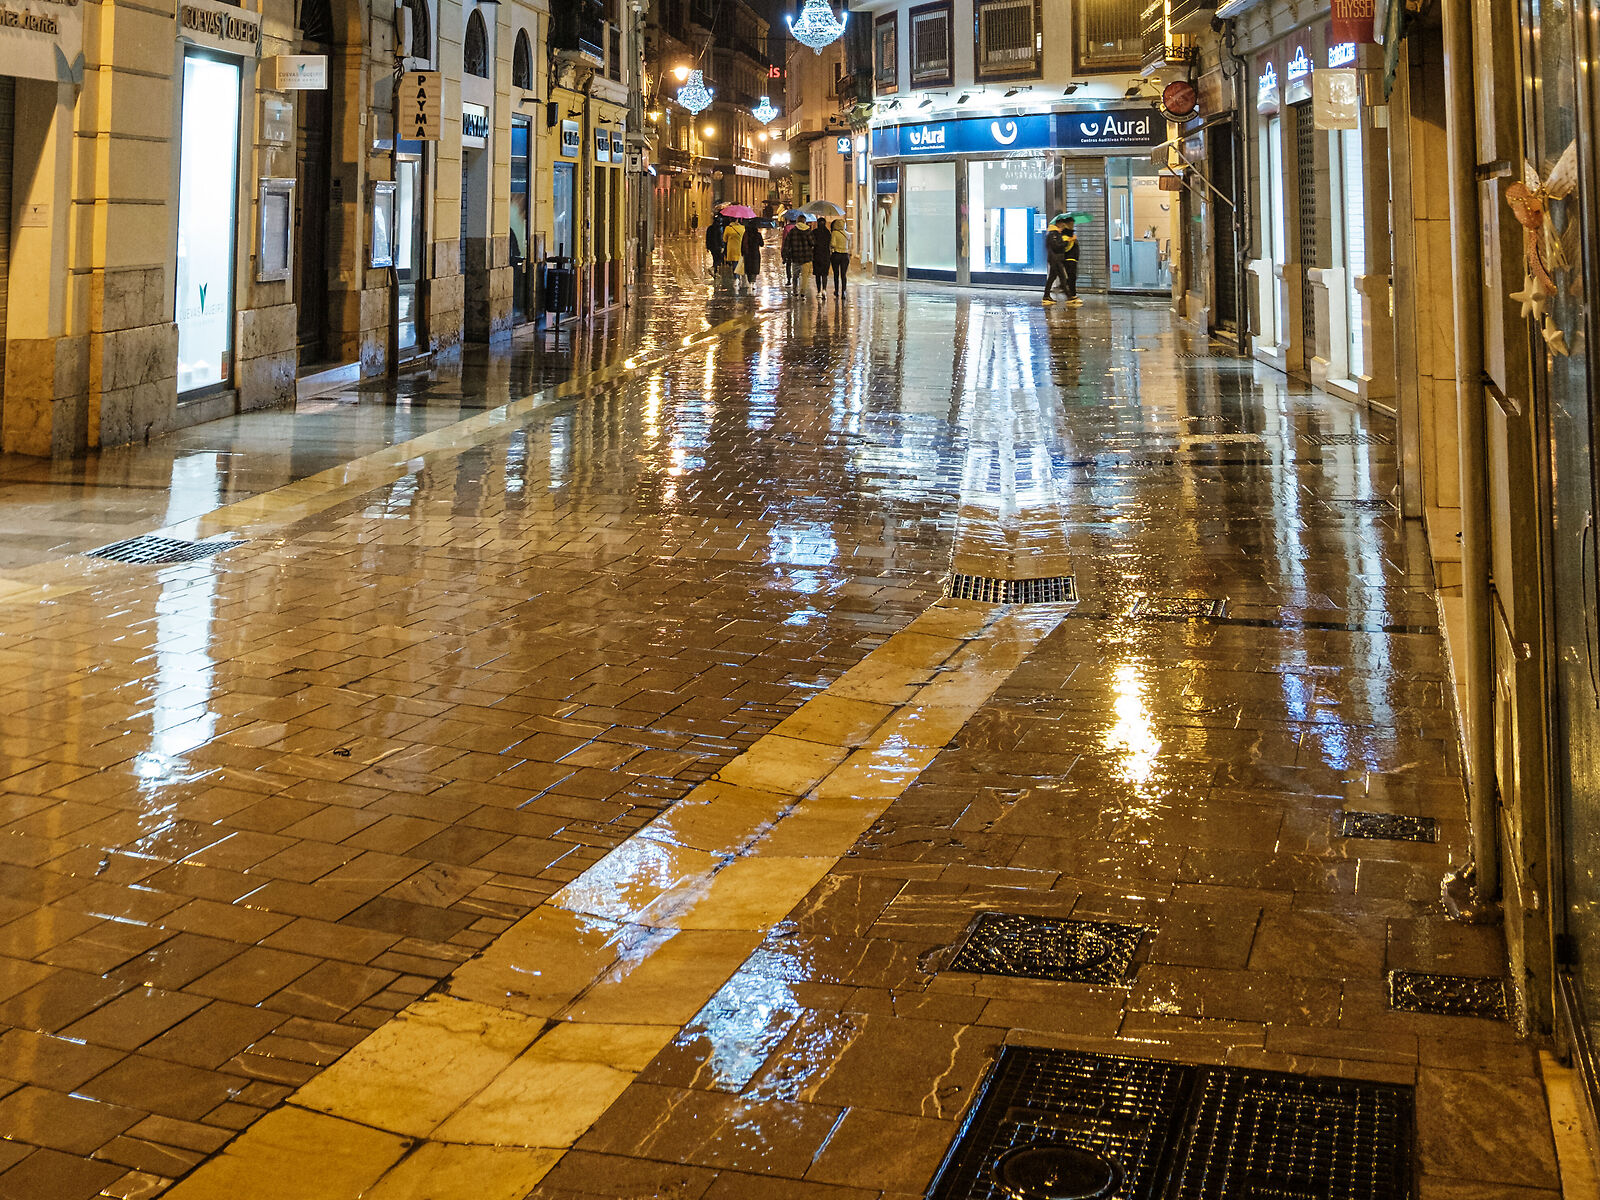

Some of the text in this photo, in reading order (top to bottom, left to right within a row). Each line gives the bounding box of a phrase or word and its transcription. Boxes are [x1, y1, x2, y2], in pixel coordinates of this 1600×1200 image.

[181, 5, 259, 44] CUEVAS QUEIPO
[415, 75, 427, 138] PAYMA
[463, 112, 489, 138] PAYMA
[921, 125, 946, 144] Aural
[1102, 115, 1150, 136] Aural
